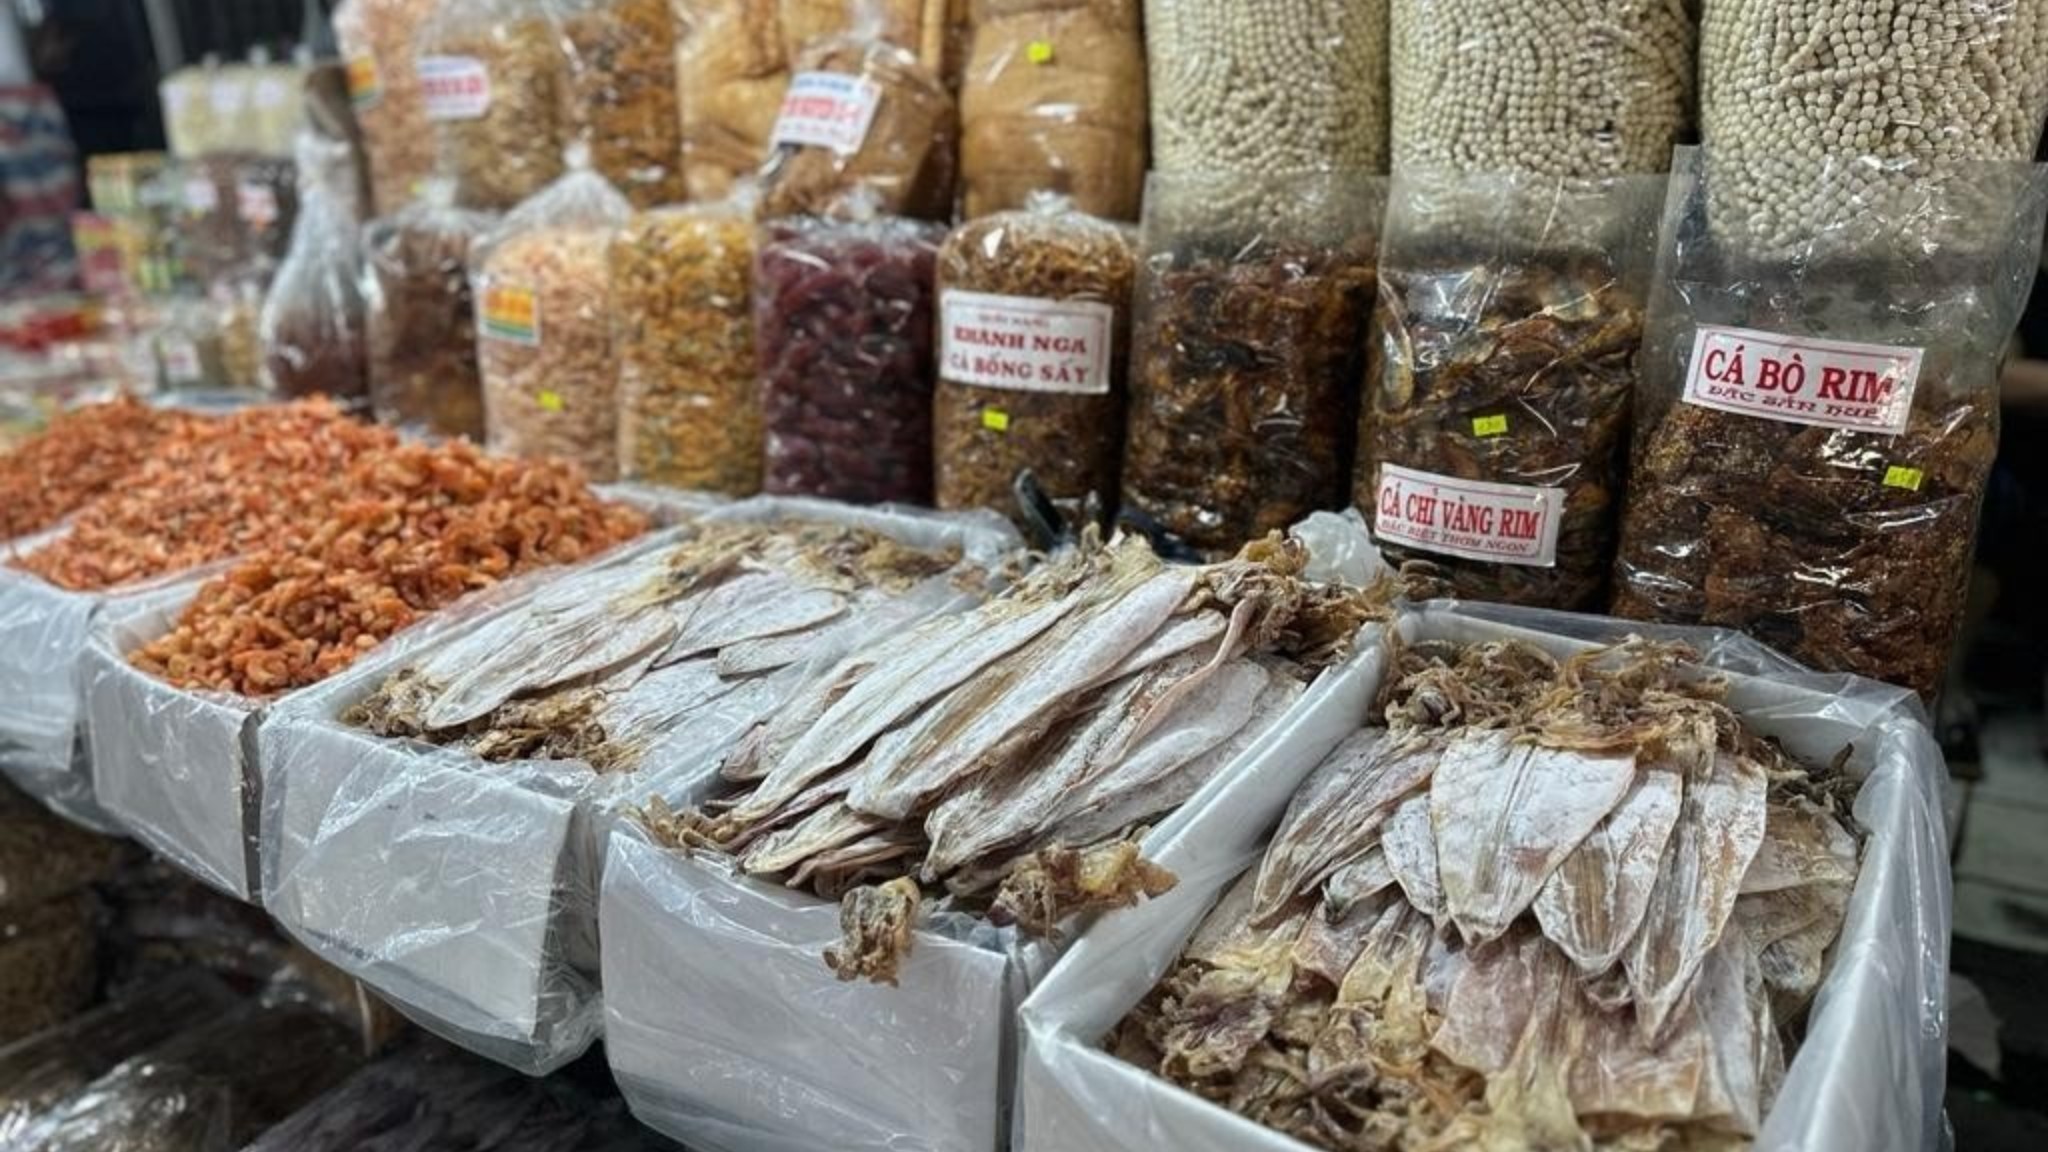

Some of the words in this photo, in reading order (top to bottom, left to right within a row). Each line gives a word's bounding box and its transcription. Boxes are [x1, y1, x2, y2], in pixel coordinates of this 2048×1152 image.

[1033, 334, 1087, 354] NGA
[1040, 357, 1089, 384] SẤY
[1705, 345, 1745, 385] CÁ
[1756, 354, 1805, 394] BÒ
[1817, 367, 1893, 405] RIM
[1381, 482, 1400, 518] CÁ
[1441, 495, 1494, 536] VÀNG
[1499, 508, 1541, 540] RIM
